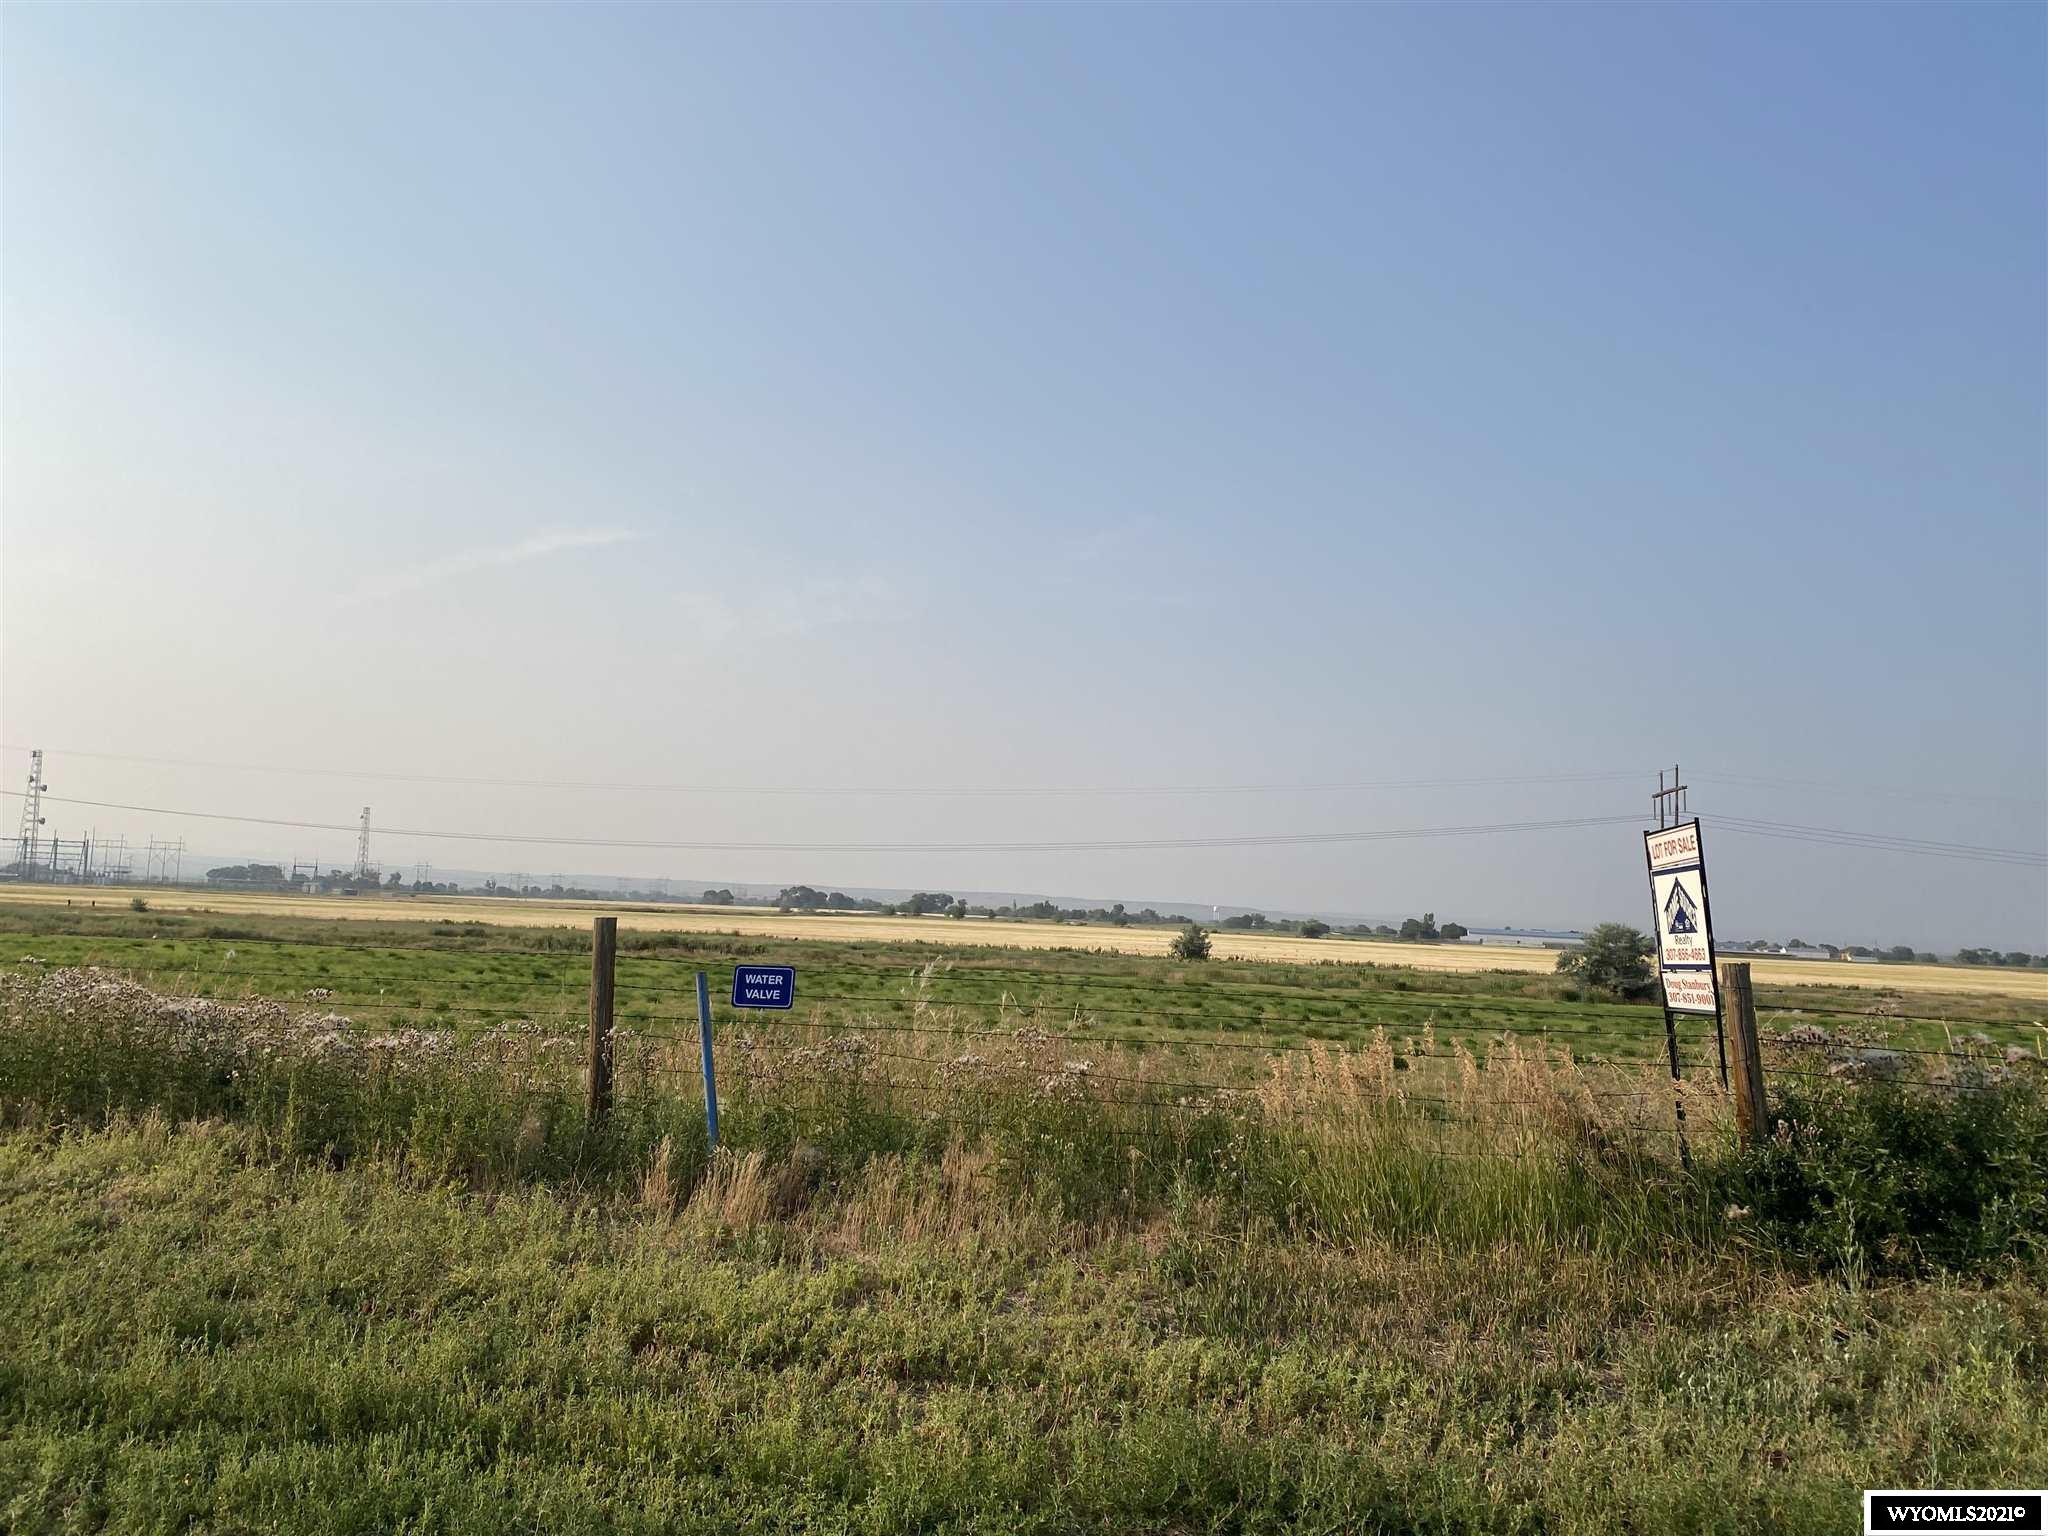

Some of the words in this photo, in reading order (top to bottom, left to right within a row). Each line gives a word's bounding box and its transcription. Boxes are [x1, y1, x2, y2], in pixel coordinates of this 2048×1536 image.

[1652, 843, 1664, 860] LOT
[1664, 840, 1678, 857] FOR
[1678, 835, 1696, 854] SALE
[1674, 934, 1693, 946] Realty
[745, 974, 783, 985] WATER
[1665, 978, 1682, 992] Doug
[1681, 979, 1711, 994] Stanbury
[745, 989, 781, 1000] VALVE
